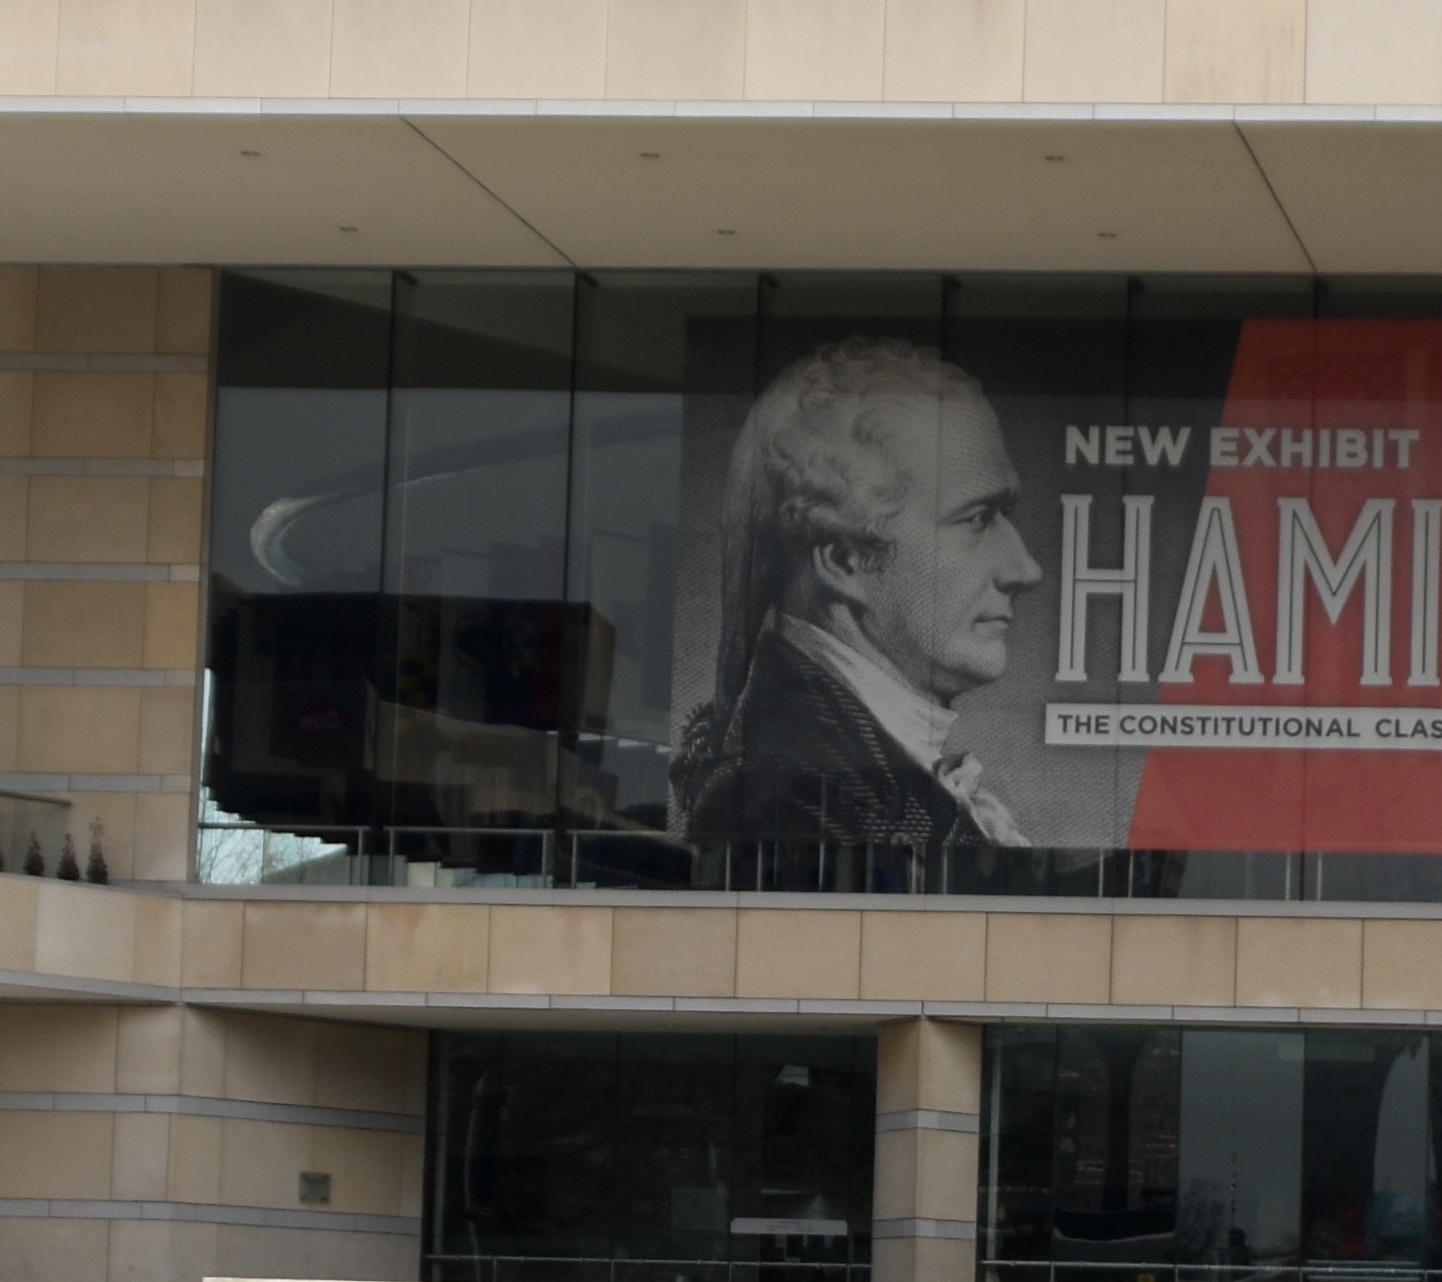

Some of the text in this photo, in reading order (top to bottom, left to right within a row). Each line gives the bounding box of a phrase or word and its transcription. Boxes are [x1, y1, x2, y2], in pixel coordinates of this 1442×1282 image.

[1064, 424, 1421, 470] NEW EXHIBIT
[1057, 713, 1110, 735] THE
[1118, 714, 1362, 739] CONSTITUTIONAL
